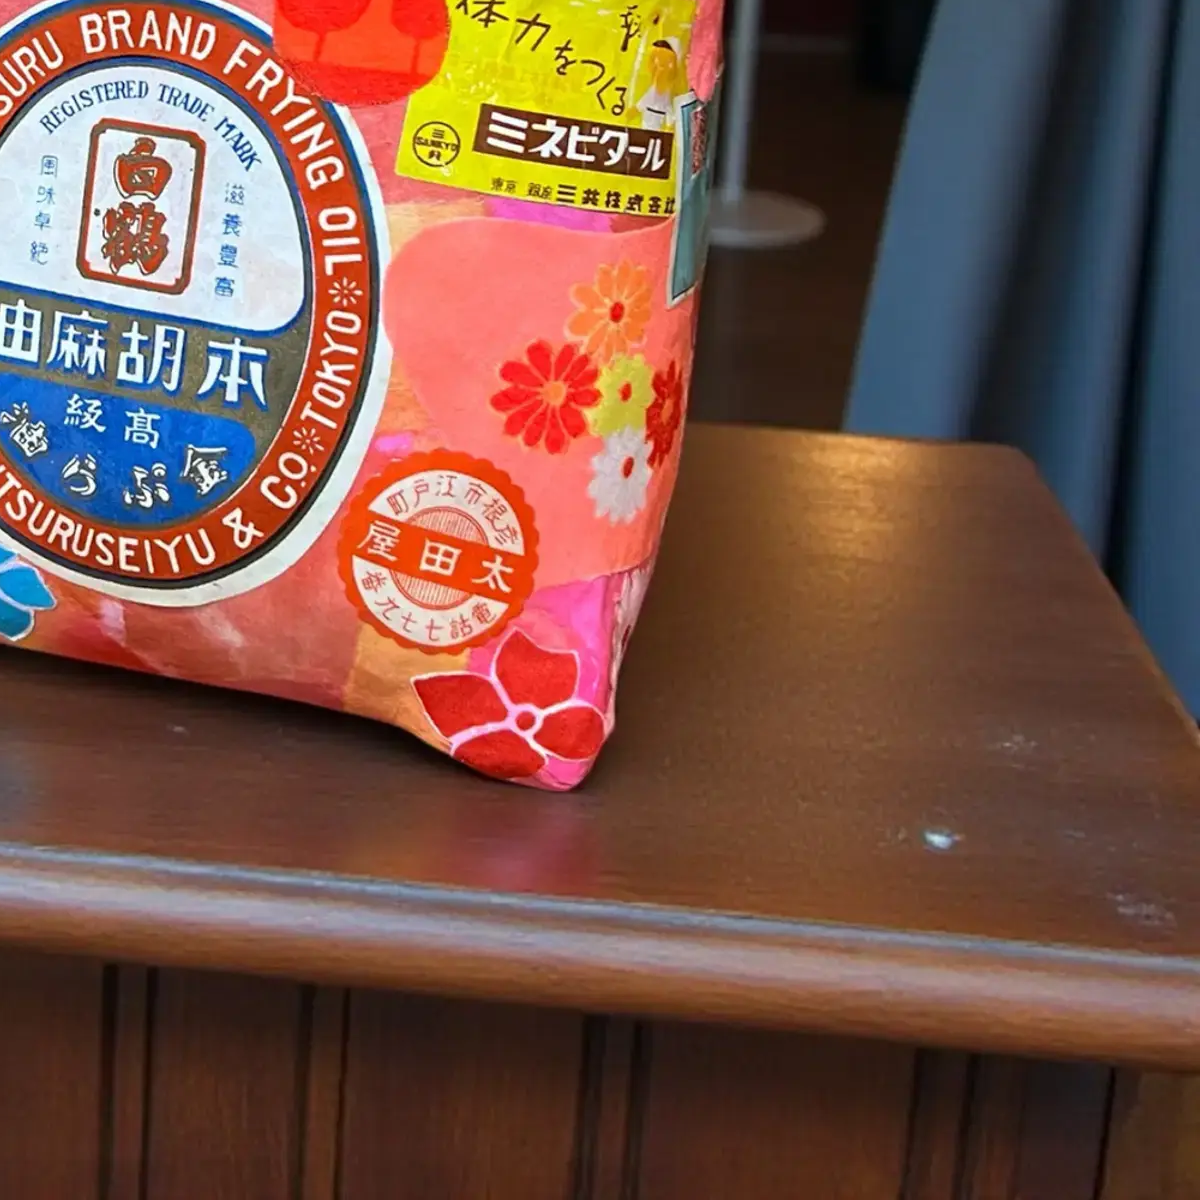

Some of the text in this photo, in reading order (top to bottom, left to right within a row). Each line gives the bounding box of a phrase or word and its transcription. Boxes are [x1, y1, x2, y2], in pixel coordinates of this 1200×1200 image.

[39, 80, 262, 172] REGISTERED TRADE MARK
[79, 9, 216, 59] BRAND
[222, 40, 343, 191] FRYING
[319, 207, 362, 276] OIL
[486, 111, 666, 172] ミネビタール
[302, 311, 362, 429] TOKYO
[222, 507, 264, 549] &
